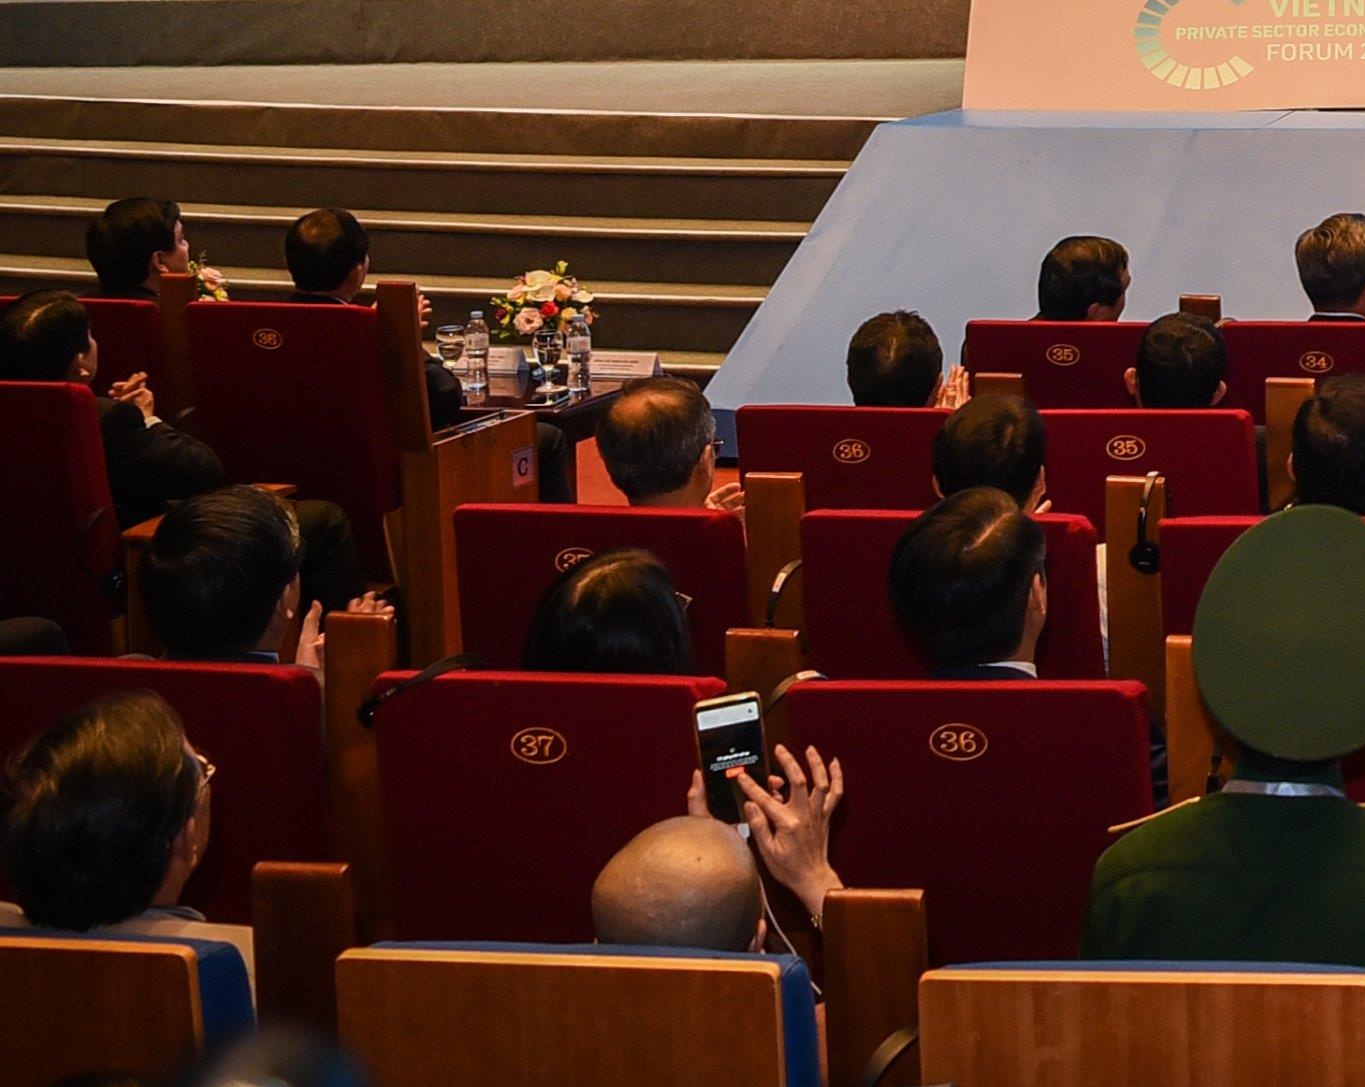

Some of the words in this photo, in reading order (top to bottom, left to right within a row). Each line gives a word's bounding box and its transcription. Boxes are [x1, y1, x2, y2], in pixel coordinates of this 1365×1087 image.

[1175, 25, 1248, 41] PRIVATE
[1252, 24, 1319, 39] SECTOR
[1267, 42, 1354, 62] FORUM
[1053, 348, 1074, 362] 35
[1307, 354, 1328, 369] 34
[839, 443, 863, 459] 36
[1113, 439, 1138, 456] 35
[516, 460, 529, 477] C
[521, 734, 556, 758] 37
[941, 730, 977, 754] 36
